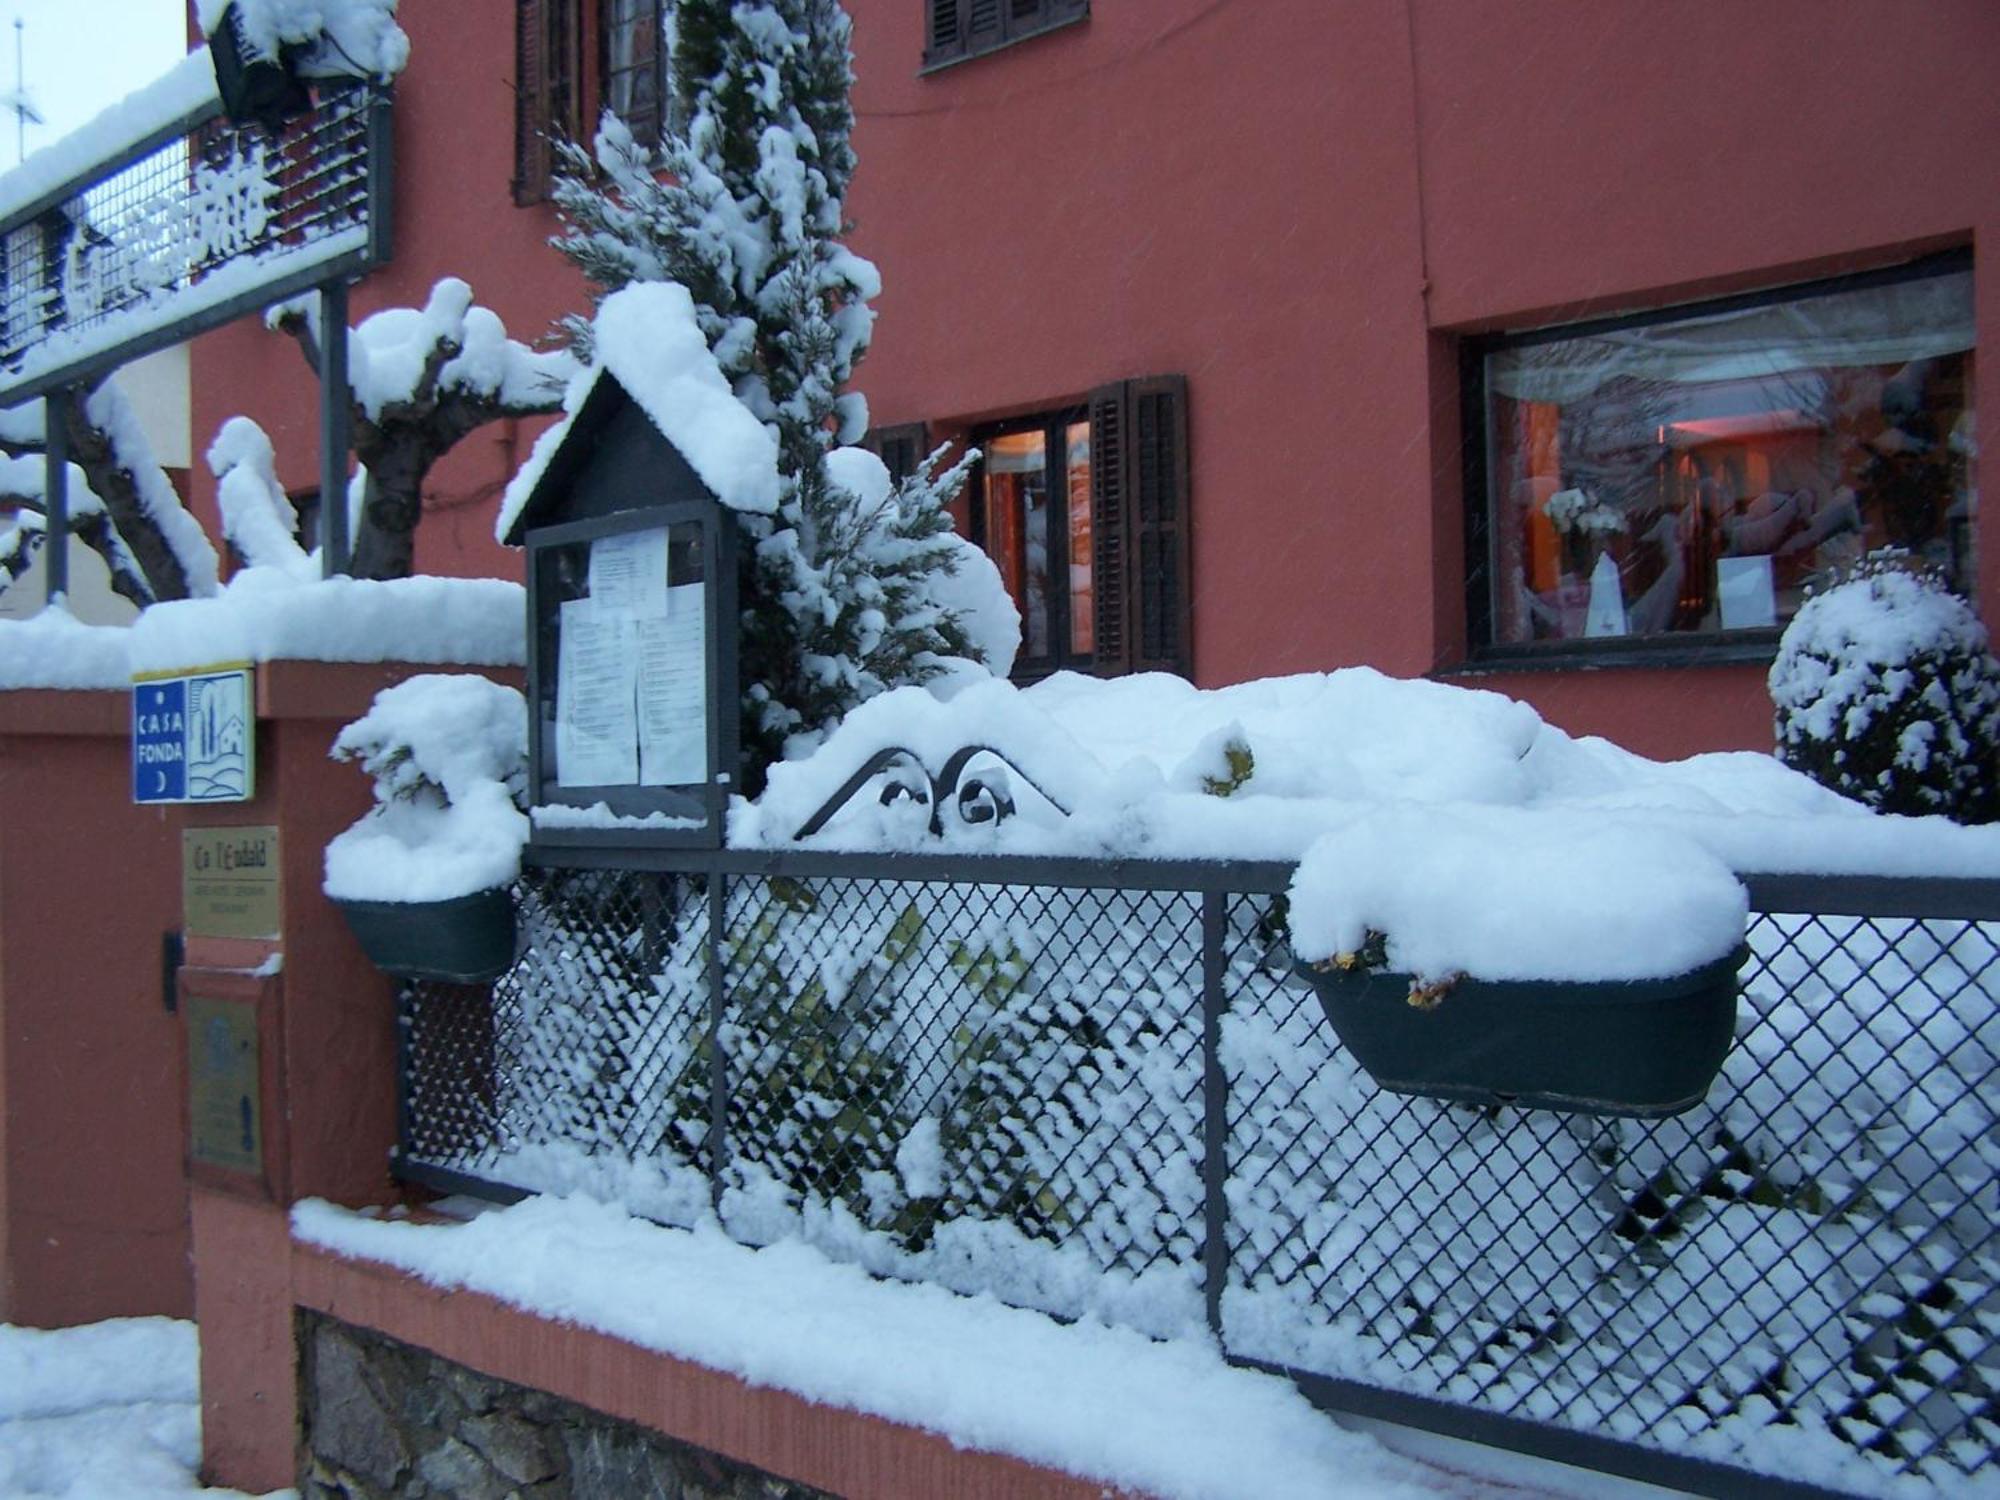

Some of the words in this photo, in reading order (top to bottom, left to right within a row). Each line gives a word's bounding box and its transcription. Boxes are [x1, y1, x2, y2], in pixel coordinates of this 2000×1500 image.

[138, 711, 184, 735] CASA
[138, 742, 184, 764] FONDA
[193, 845, 210, 871] Ca
